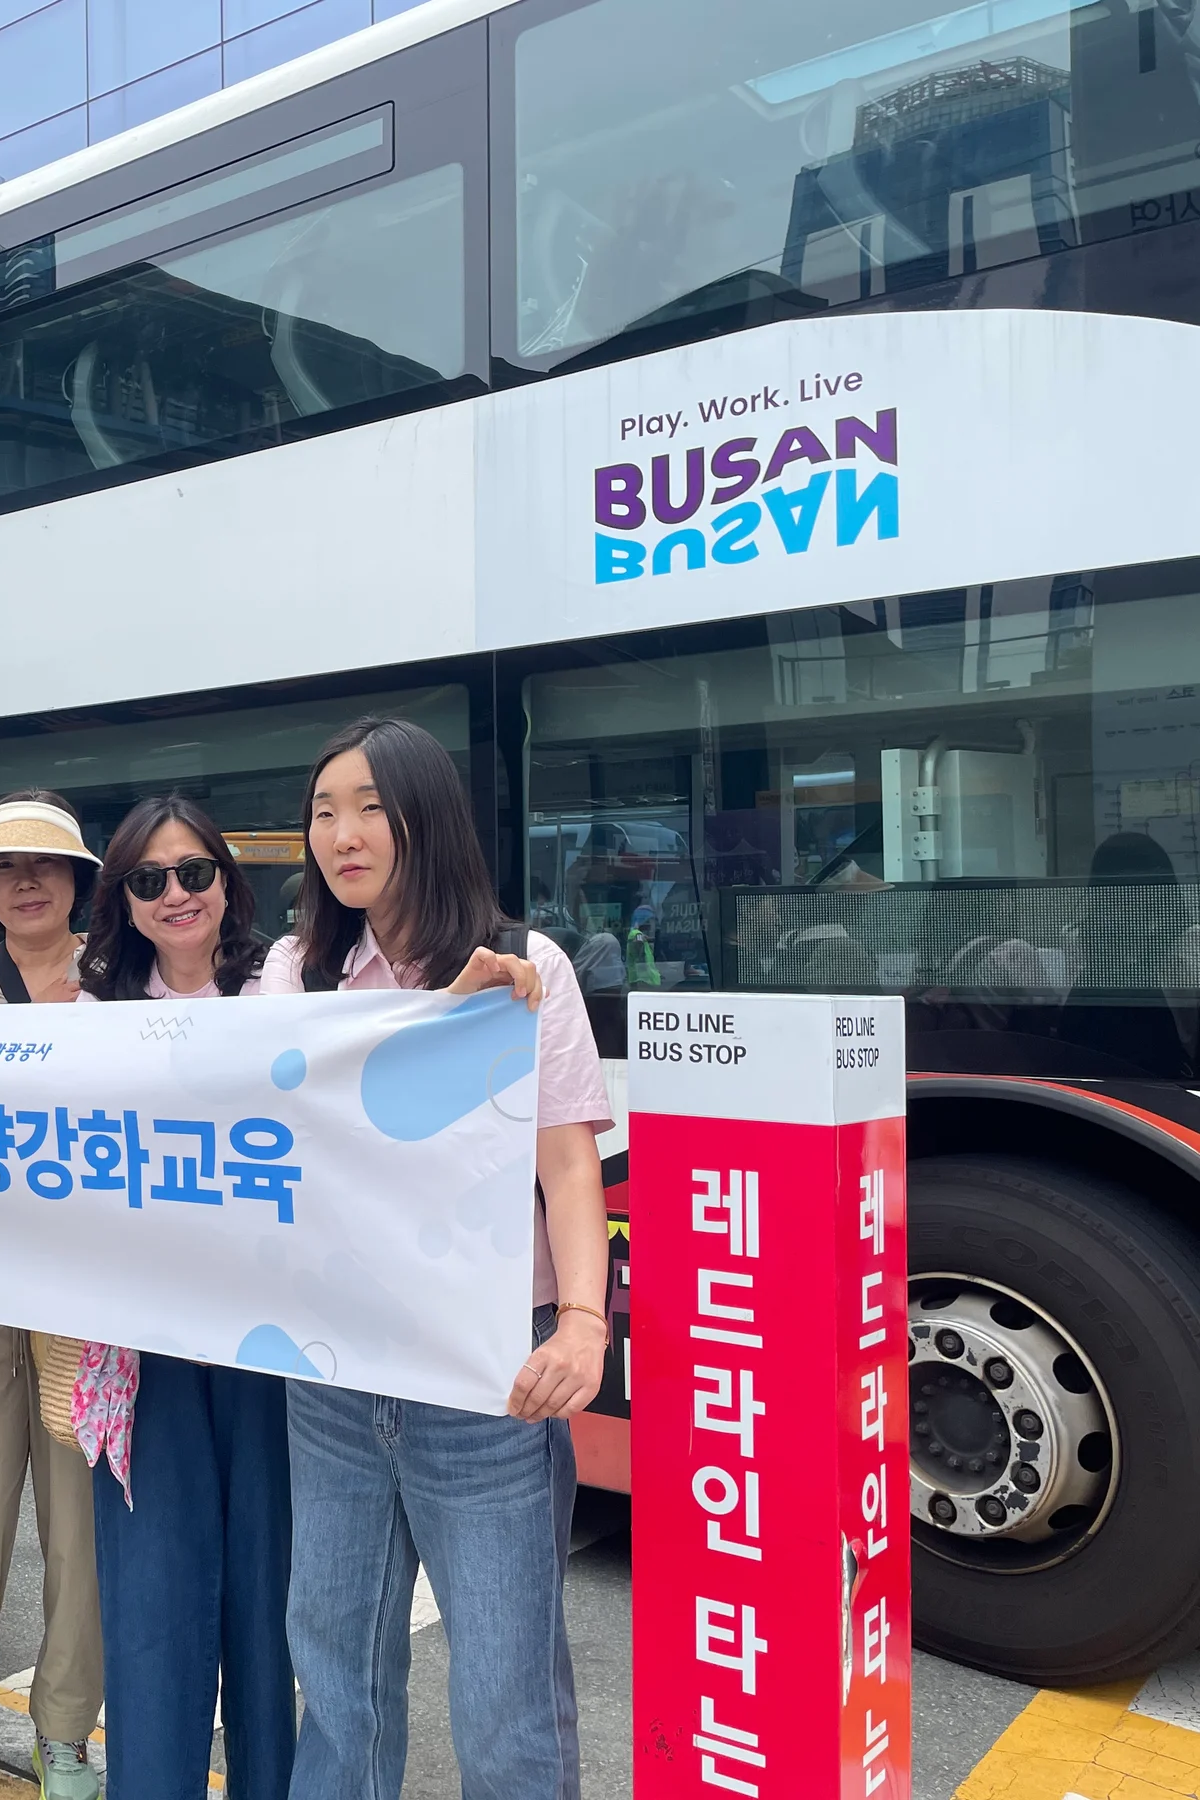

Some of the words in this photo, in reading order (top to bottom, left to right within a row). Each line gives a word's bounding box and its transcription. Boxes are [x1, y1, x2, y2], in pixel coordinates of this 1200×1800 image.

[620, 409, 689, 441] Play.
[697, 385, 789, 423] Work.
[799, 371, 864, 403] Live
[594, 407, 899, 531] BUSAN
[638, 1011, 680, 1032] RED
[686, 1013, 735, 1034] LINE
[638, 1042, 683, 1062] BUS
[689, 1043, 747, 1065] STOP
[835, 1016, 854, 1037] RED
[856, 1016, 876, 1037] LINE
[836, 1048, 856, 1069] BUS
[857, 1047, 880, 1069] STOP
[689, 1168, 766, 1562] 레드라인
[858, 1168, 888, 1560] 레드라인
[692, 1595, 768, 1799] 타는
[862, 1595, 890, 1798] 타는
